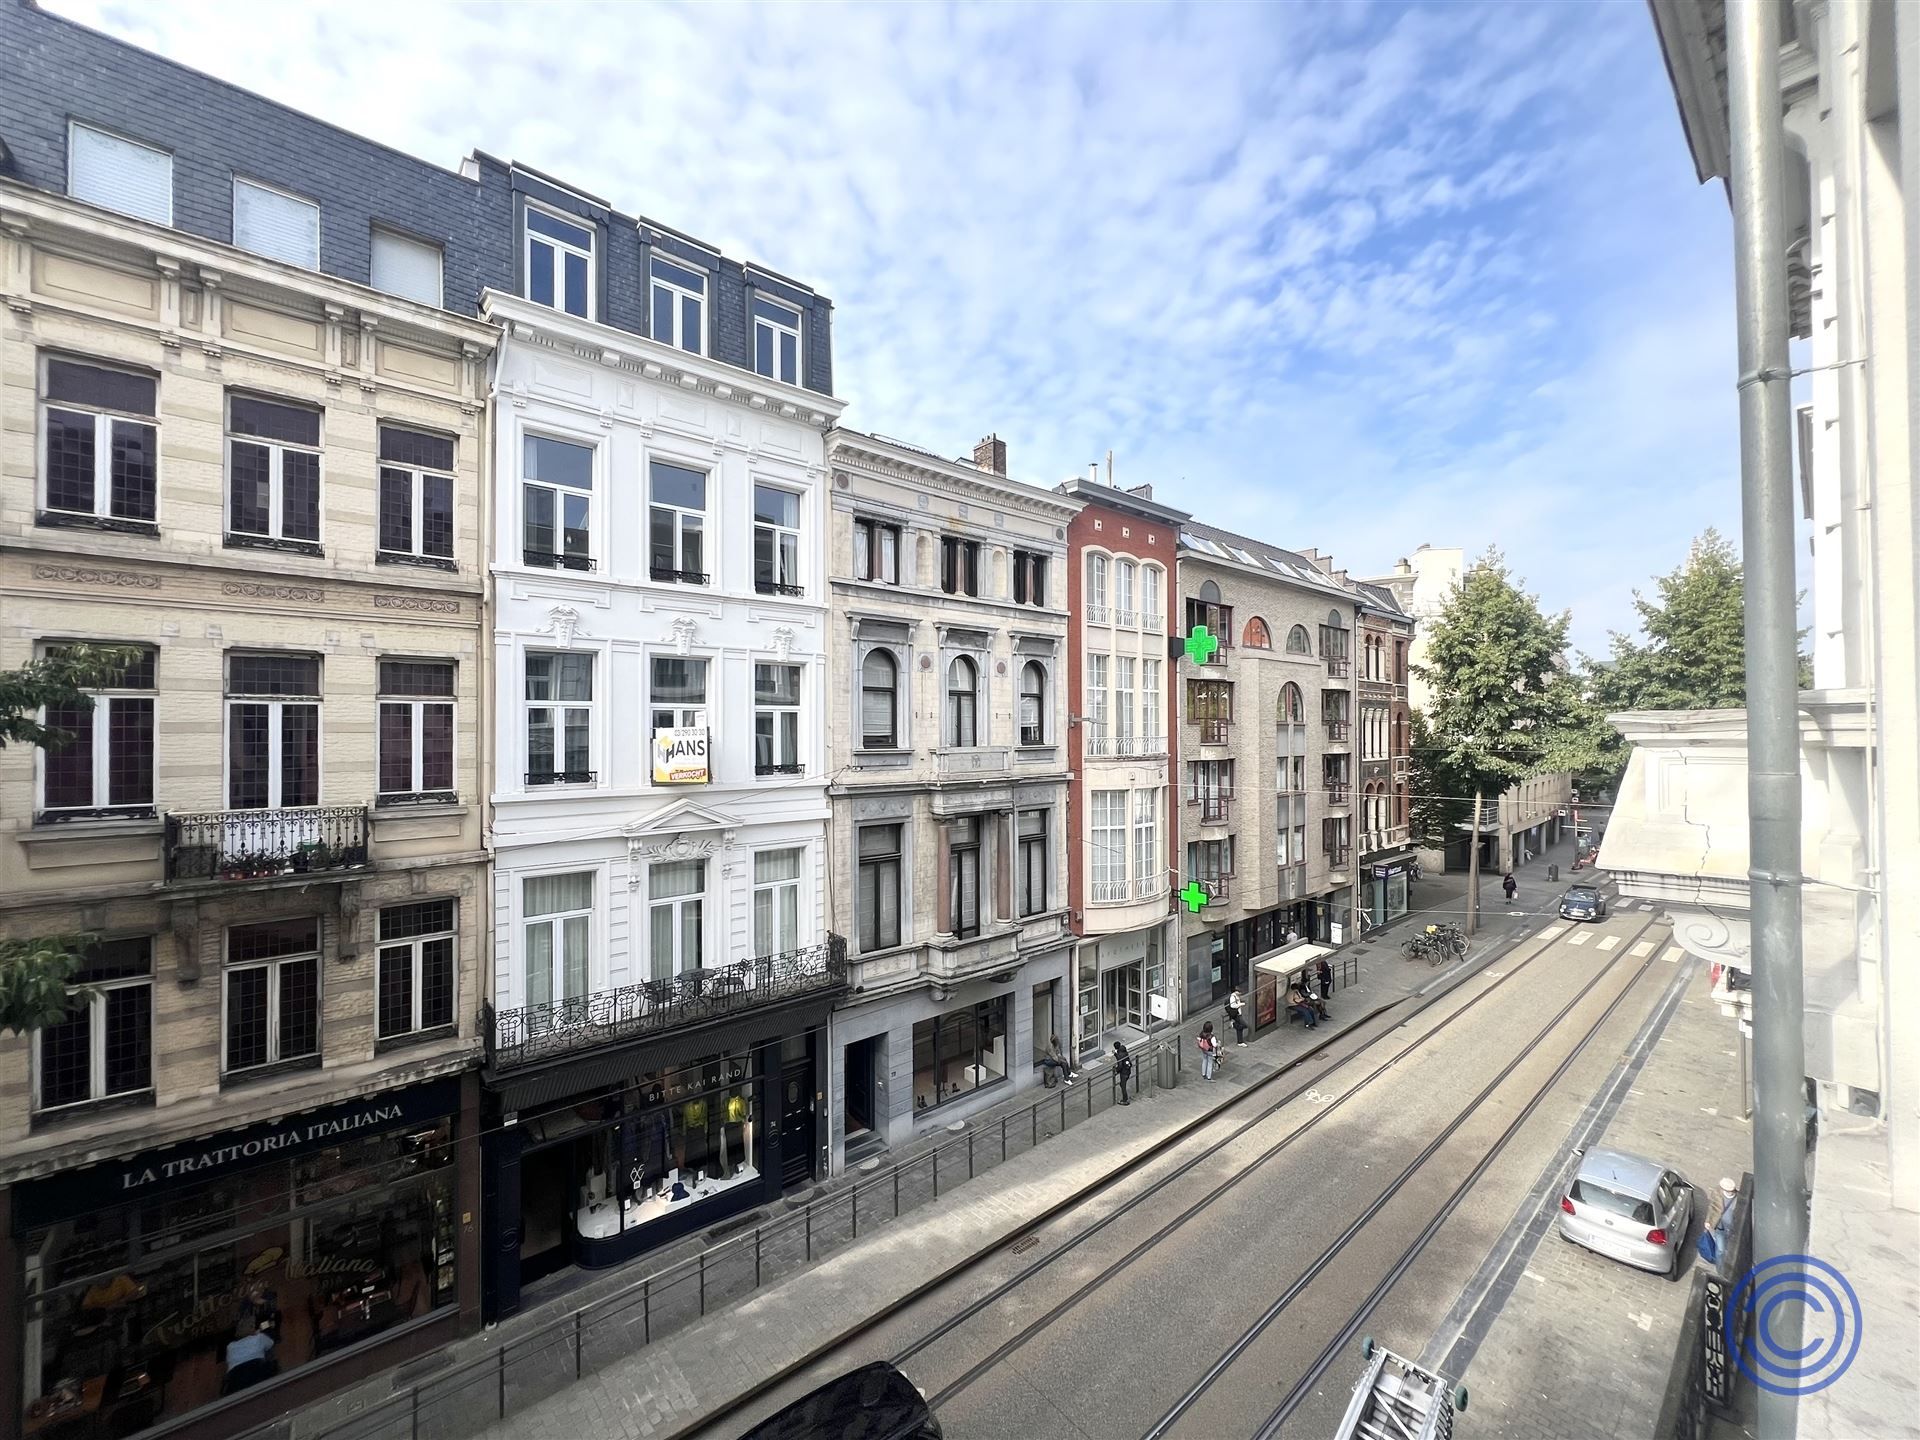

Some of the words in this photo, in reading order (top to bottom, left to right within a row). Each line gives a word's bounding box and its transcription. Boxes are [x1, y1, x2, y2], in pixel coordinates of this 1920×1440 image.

[649, 1085, 681, 1102] BITTE
[687, 1079, 706, 1091] KAI
[711, 1069, 741, 1084] RAND
[122, 1168, 158, 1190] LA
[161, 1130, 303, 1178] TRATTORIA
[307, 1104, 404, 1141] ITALIANA
